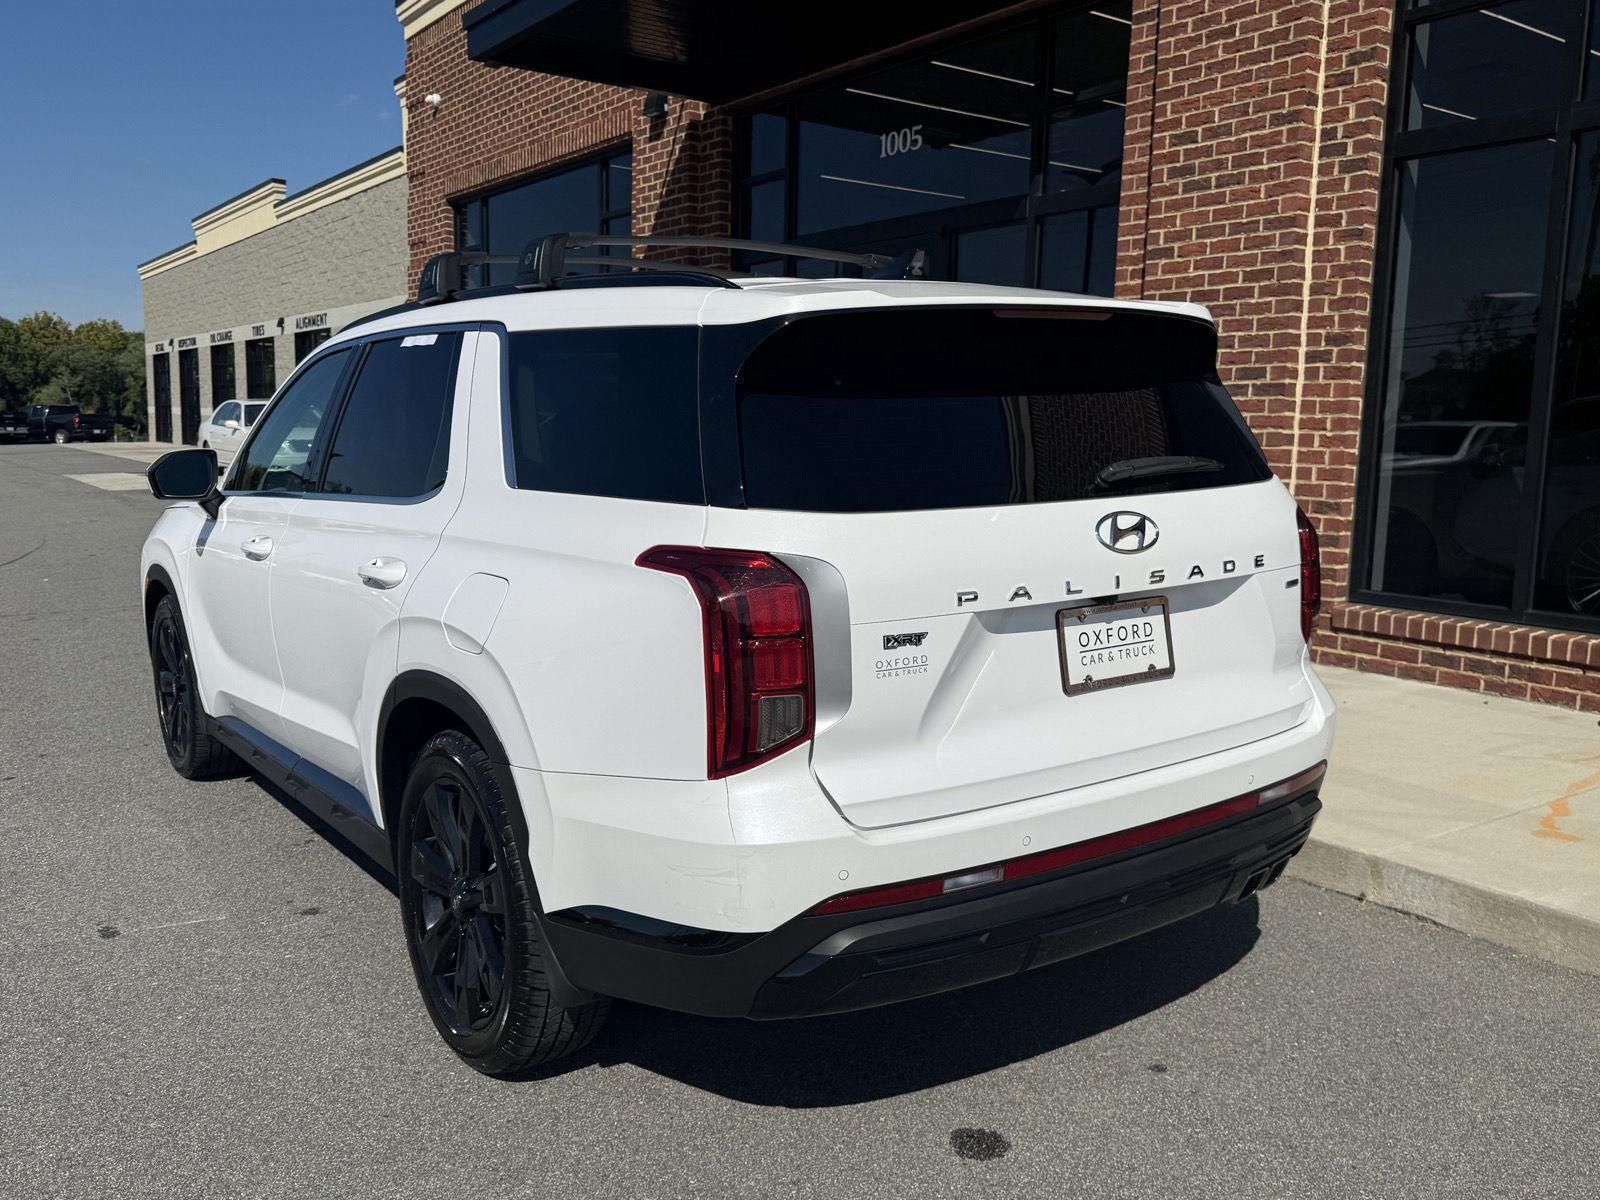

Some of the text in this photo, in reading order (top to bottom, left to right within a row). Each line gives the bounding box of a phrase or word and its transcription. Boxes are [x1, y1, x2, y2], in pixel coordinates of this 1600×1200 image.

[880, 124, 922, 158] 1005
[296, 313, 328, 330] ALIGNMENT
[217, 330, 233, 342] CHANGE
[251, 325, 265, 337] TIRES
[957, 553, 1266, 607] PALISADE
[883, 631, 929, 650] XRT
[1078, 622, 1153, 648] OXFORD
[875, 654, 928, 670] OXFORD
[1080, 644, 1156, 667] CAR & TRUCK
[876, 671, 893, 680] CAR
[902, 667, 928, 676] TRUCK
